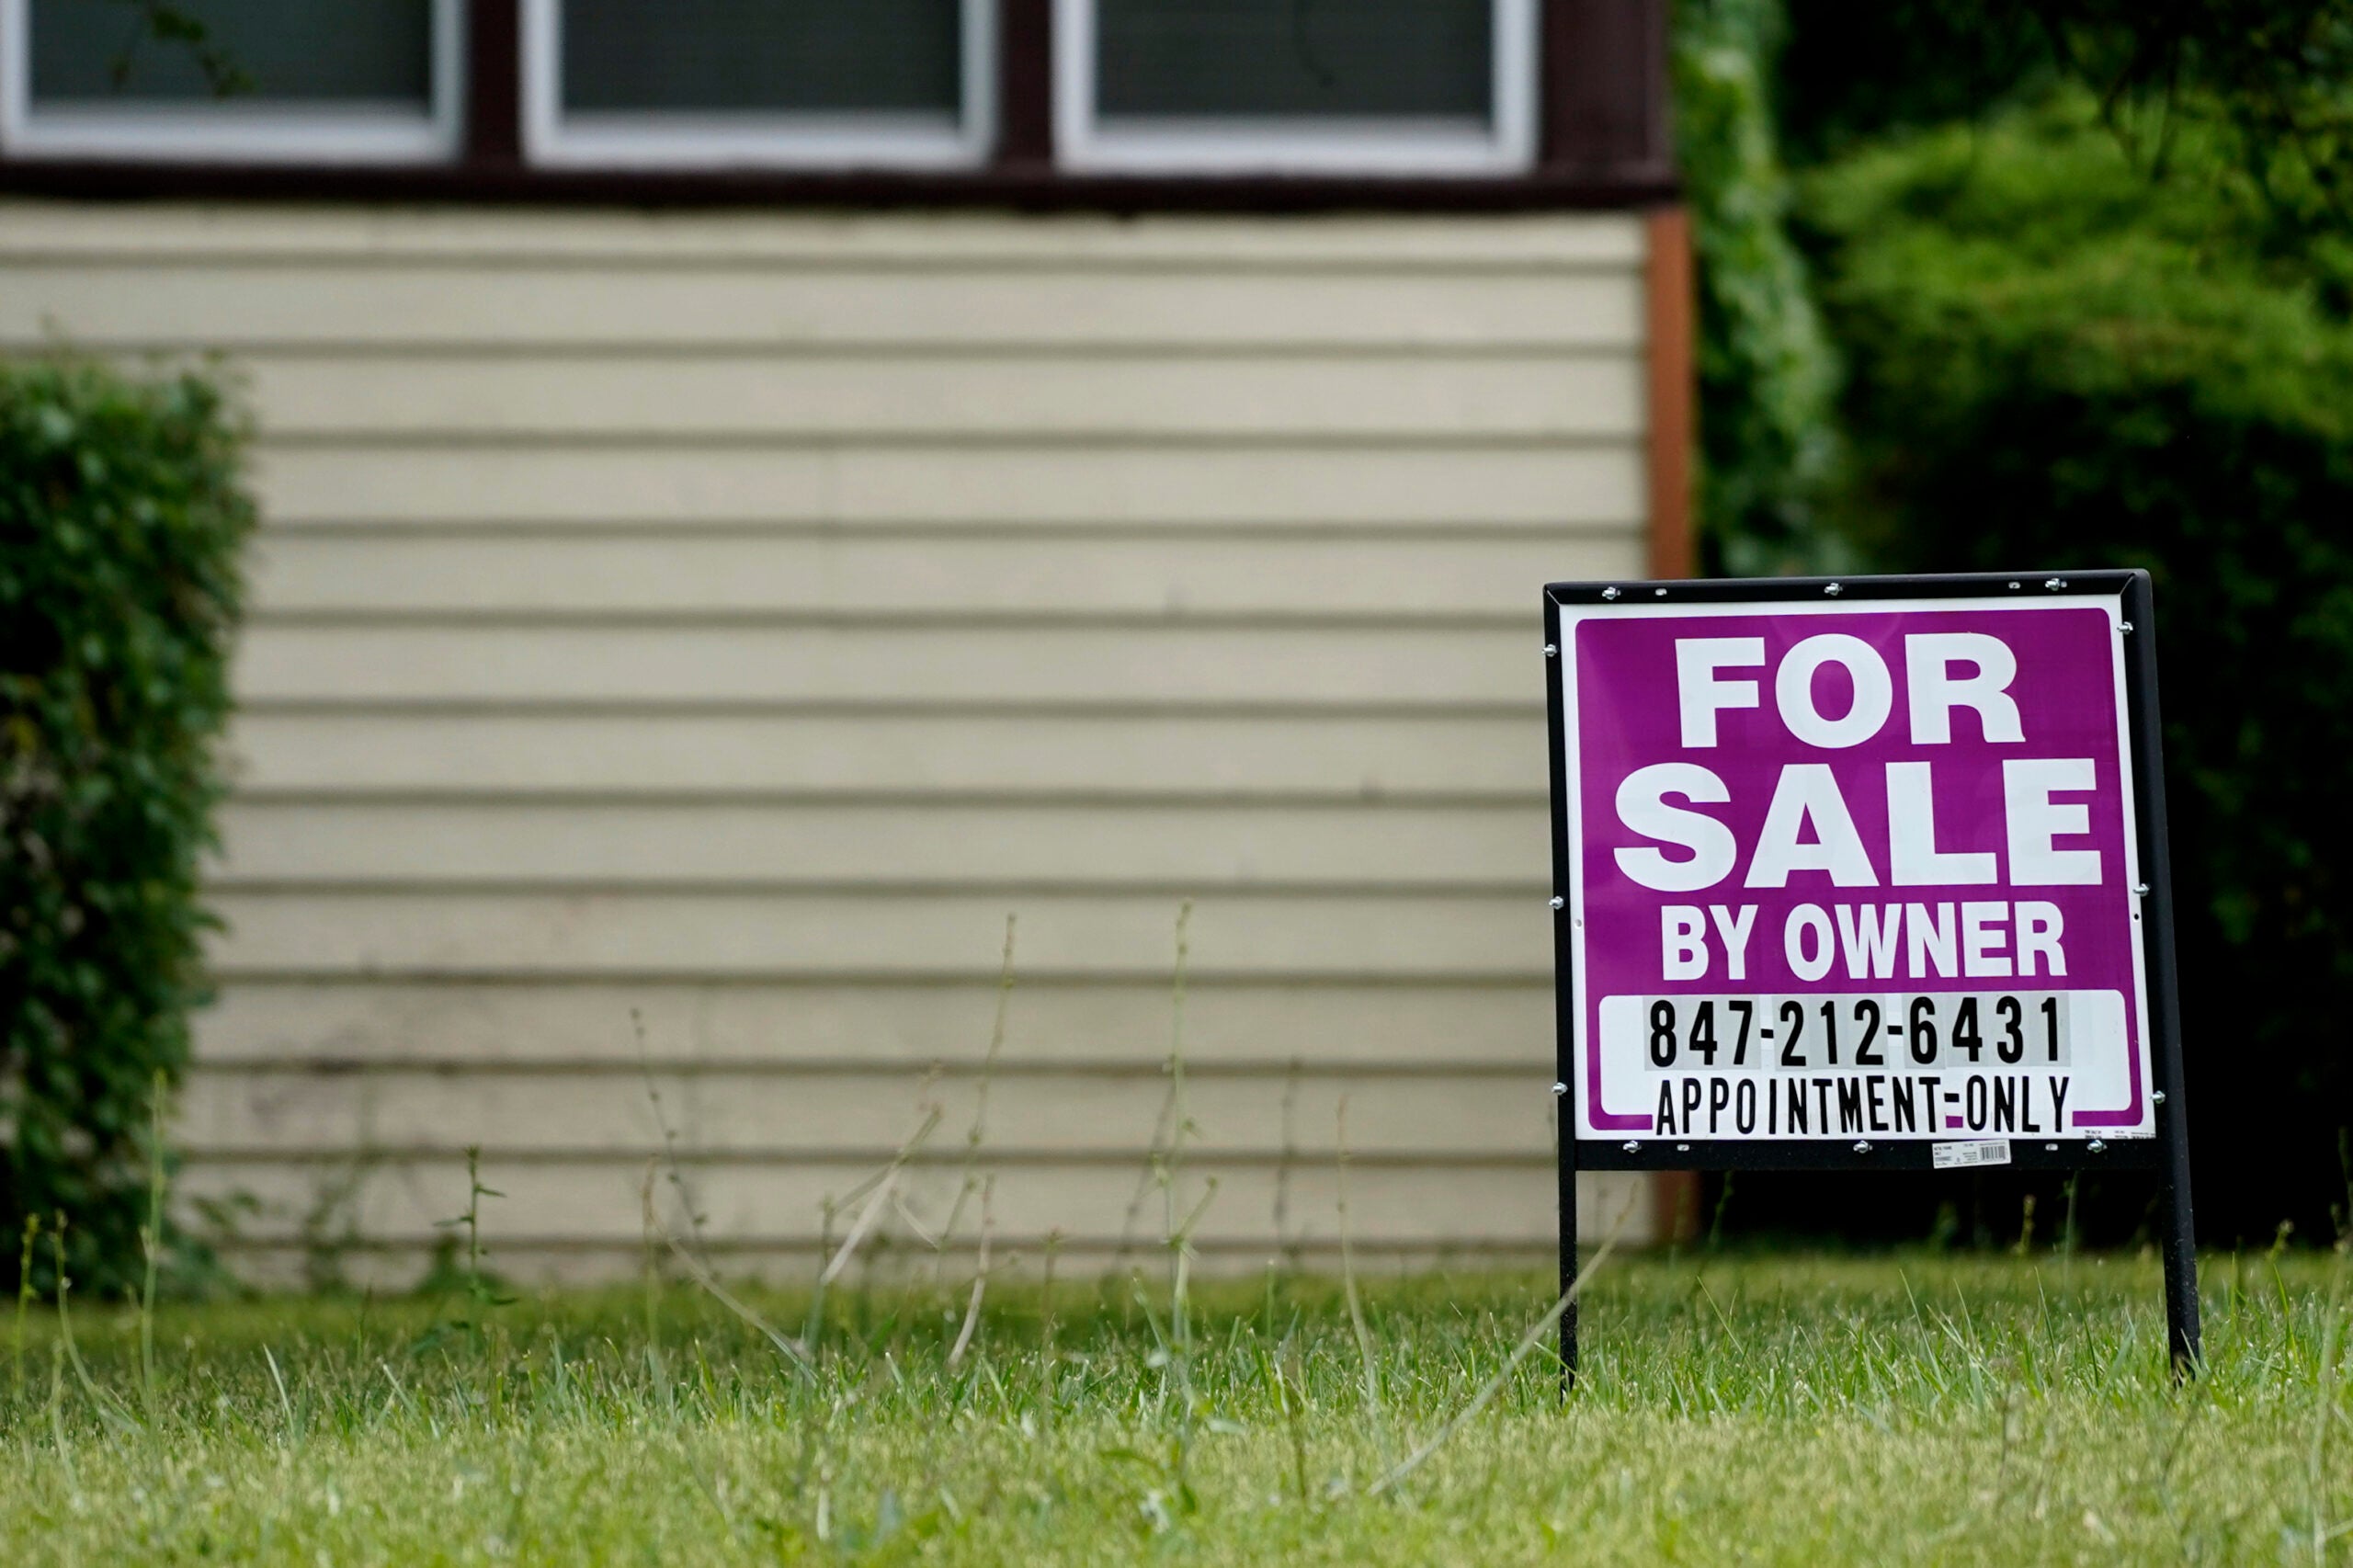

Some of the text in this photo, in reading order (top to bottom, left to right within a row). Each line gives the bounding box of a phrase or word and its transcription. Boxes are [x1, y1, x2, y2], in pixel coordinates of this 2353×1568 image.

[1675, 632, 2027, 749] FOR
[1613, 757, 2104, 892] SALE
[1661, 900, 2068, 983] BY OWNER
[1649, 995, 2059, 1068] 847-212-6431
[1655, 1074, 2070, 1136] APPOINTMENT-ONLY
